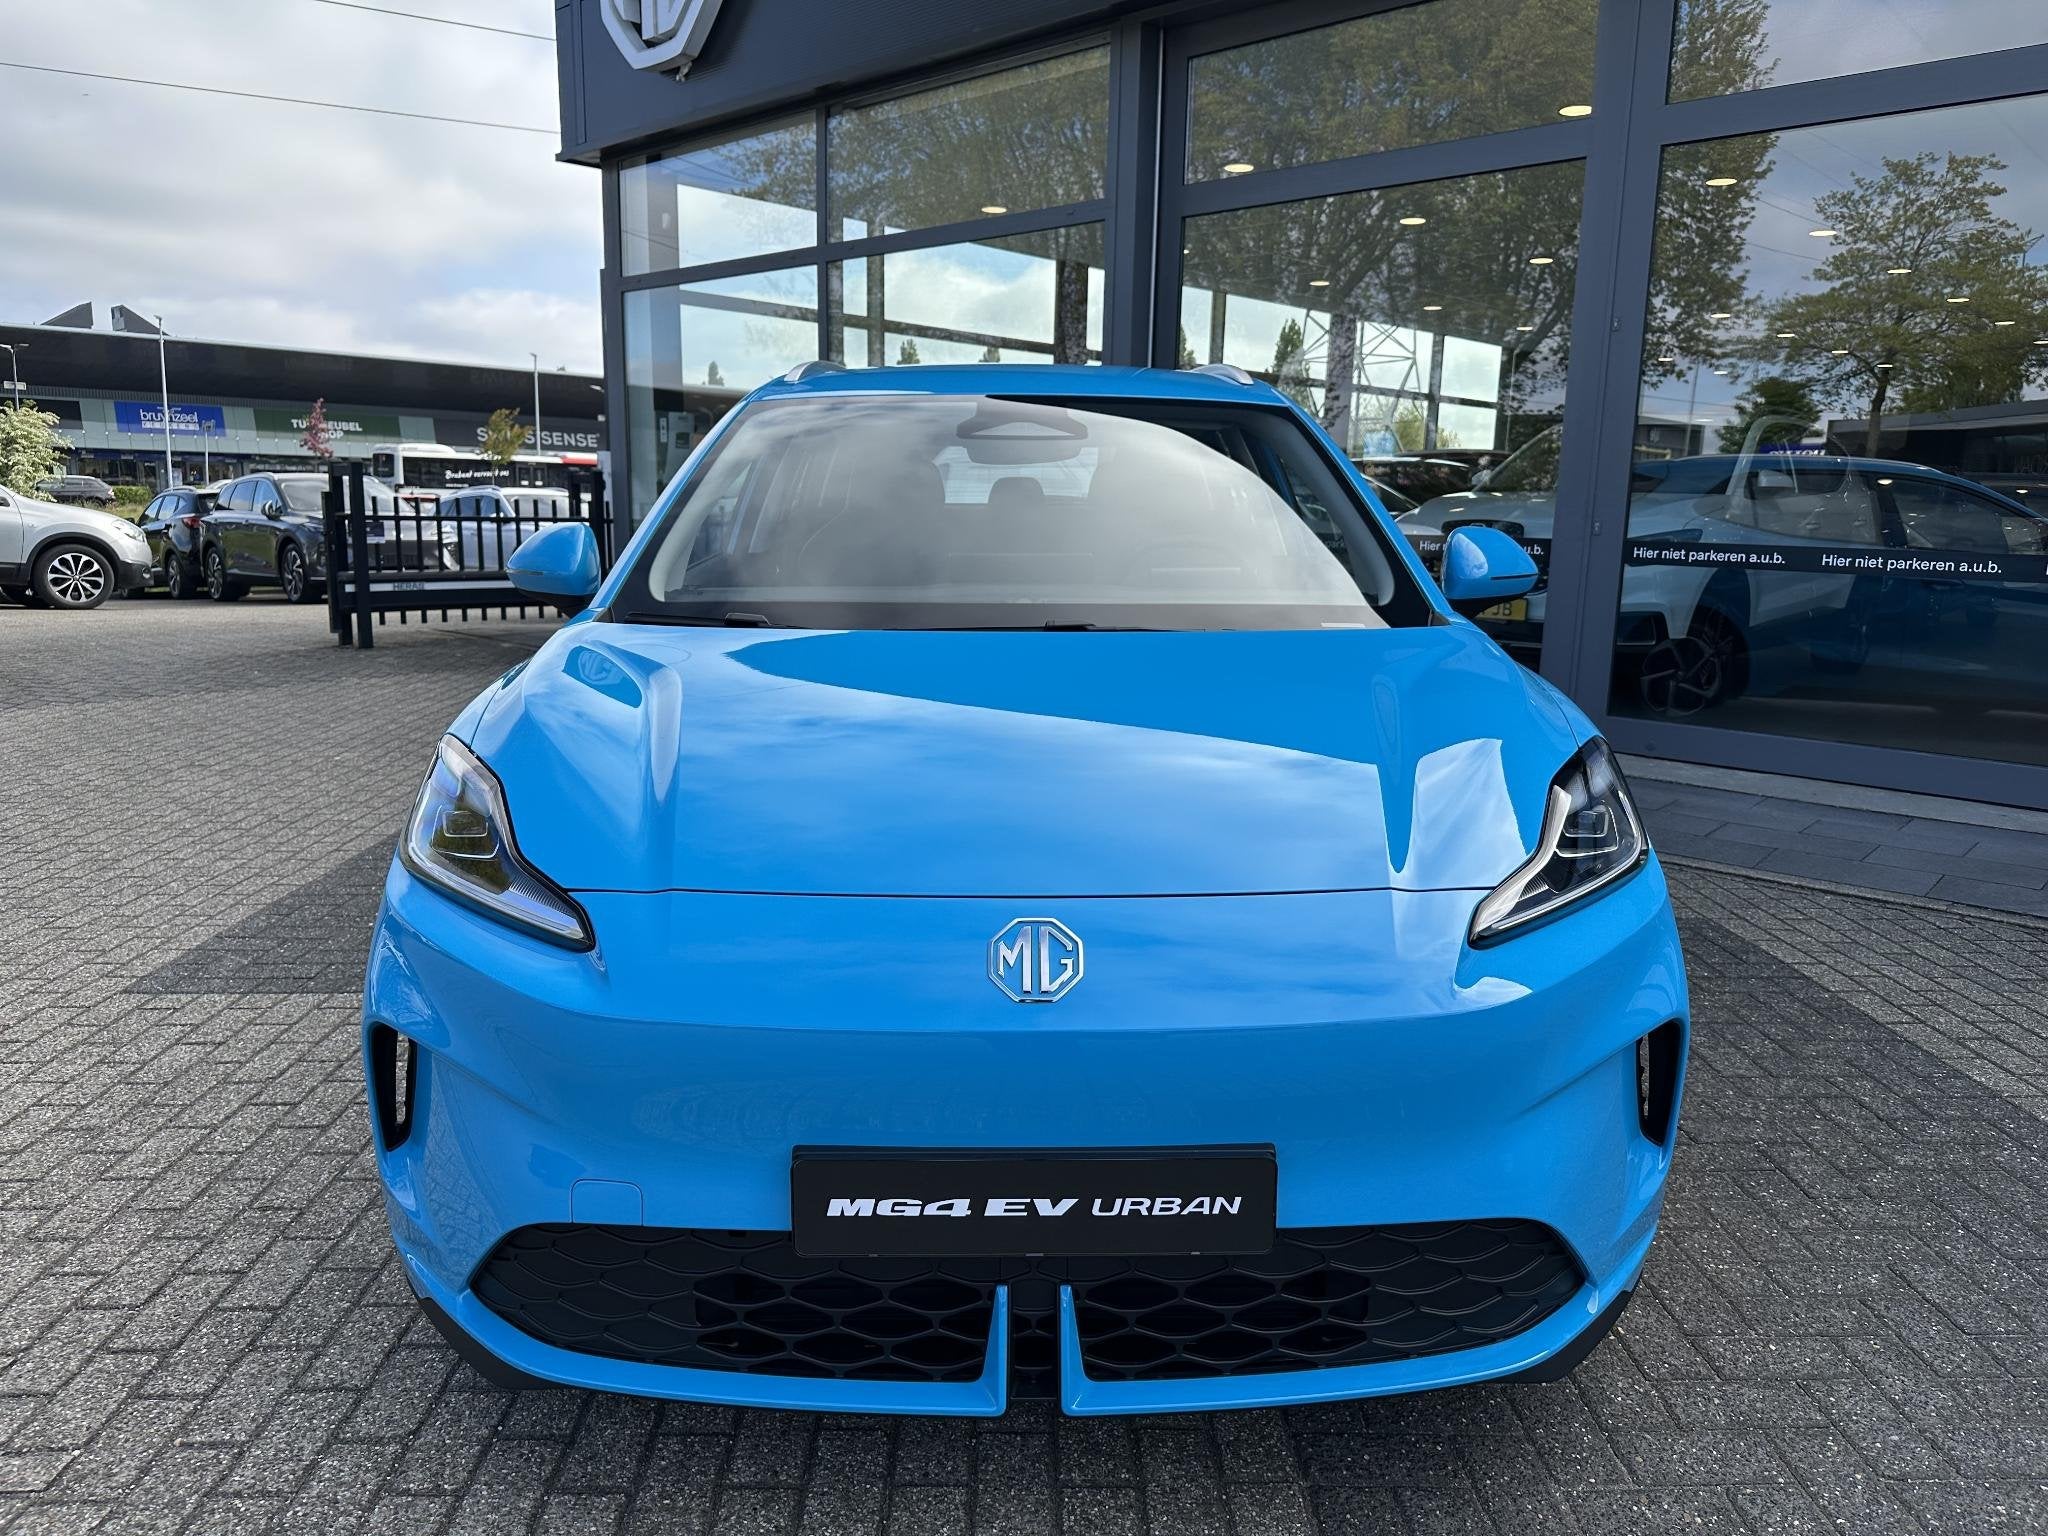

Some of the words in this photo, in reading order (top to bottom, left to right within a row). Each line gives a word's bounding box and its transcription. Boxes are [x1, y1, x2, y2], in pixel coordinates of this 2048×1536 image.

[291, 419, 363, 431] TUEUBEL
[541, 431, 598, 448] SENSE
[1419, 541, 1441, 551] Hier
[1524, 544, 1544, 555] u.b.
[1633, 547, 1659, 558] Hier
[1661, 548, 1686, 560] niet
[1688, 550, 1746, 563] parkeren
[1749, 553, 1786, 564] a.u.b.
[1821, 554, 1852, 567] Hier
[1855, 555, 1884, 569] niet
[1887, 558, 1955, 572] parkeren
[1959, 561, 2002, 574] a.u.b.
[997, 926, 1074, 993] MG
[826, 1198, 972, 1217] MG4
[984, 1198, 1079, 1217] EV
[1091, 1196, 1242, 1216] URBAN
